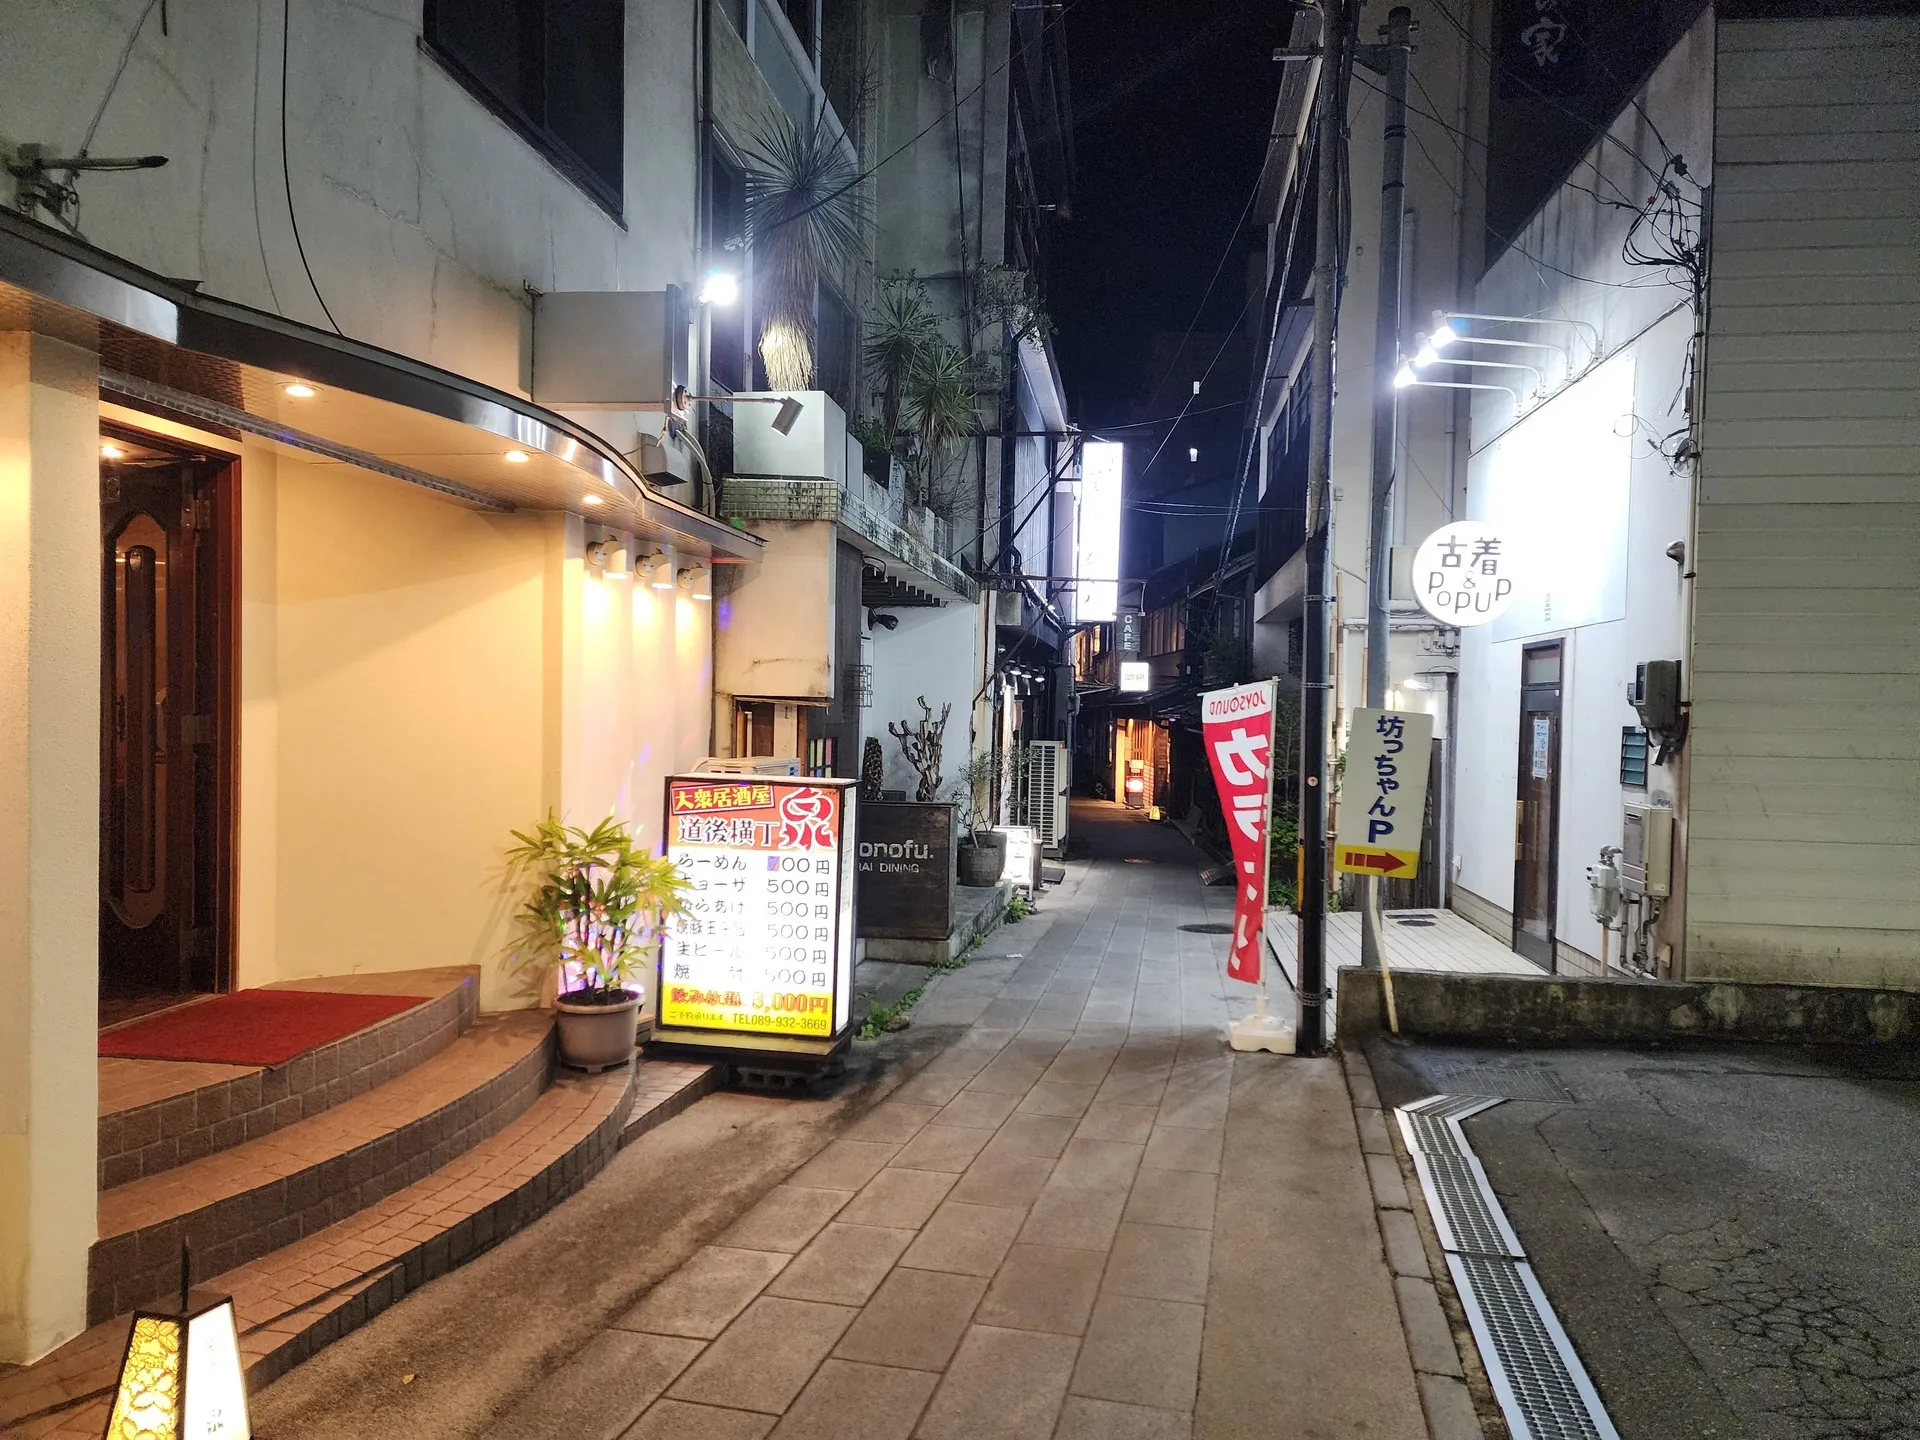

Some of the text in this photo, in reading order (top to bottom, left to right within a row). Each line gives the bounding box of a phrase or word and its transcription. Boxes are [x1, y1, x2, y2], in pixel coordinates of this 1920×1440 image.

[1520, 0, 1568, 68] 家
[1437, 535, 1502, 576] 古着
[1463, 570, 1476, 589] &
[1123, 614, 1133, 650] CAFE
[1368, 715, 1406, 844] 坊っちゃんP
[674, 785, 771, 811] 大衆居酒屋
[678, 817, 780, 846] 道後横丁
[679, 852, 830, 875] らーめん 00円
[880, 863, 920, 873] DINING
[766, 879, 829, 897] 500円
[766, 901, 829, 919] 500円
[766, 923, 829, 942] 500円
[764, 946, 827, 964] 500円
[751, 991, 829, 1015] 3,000円
